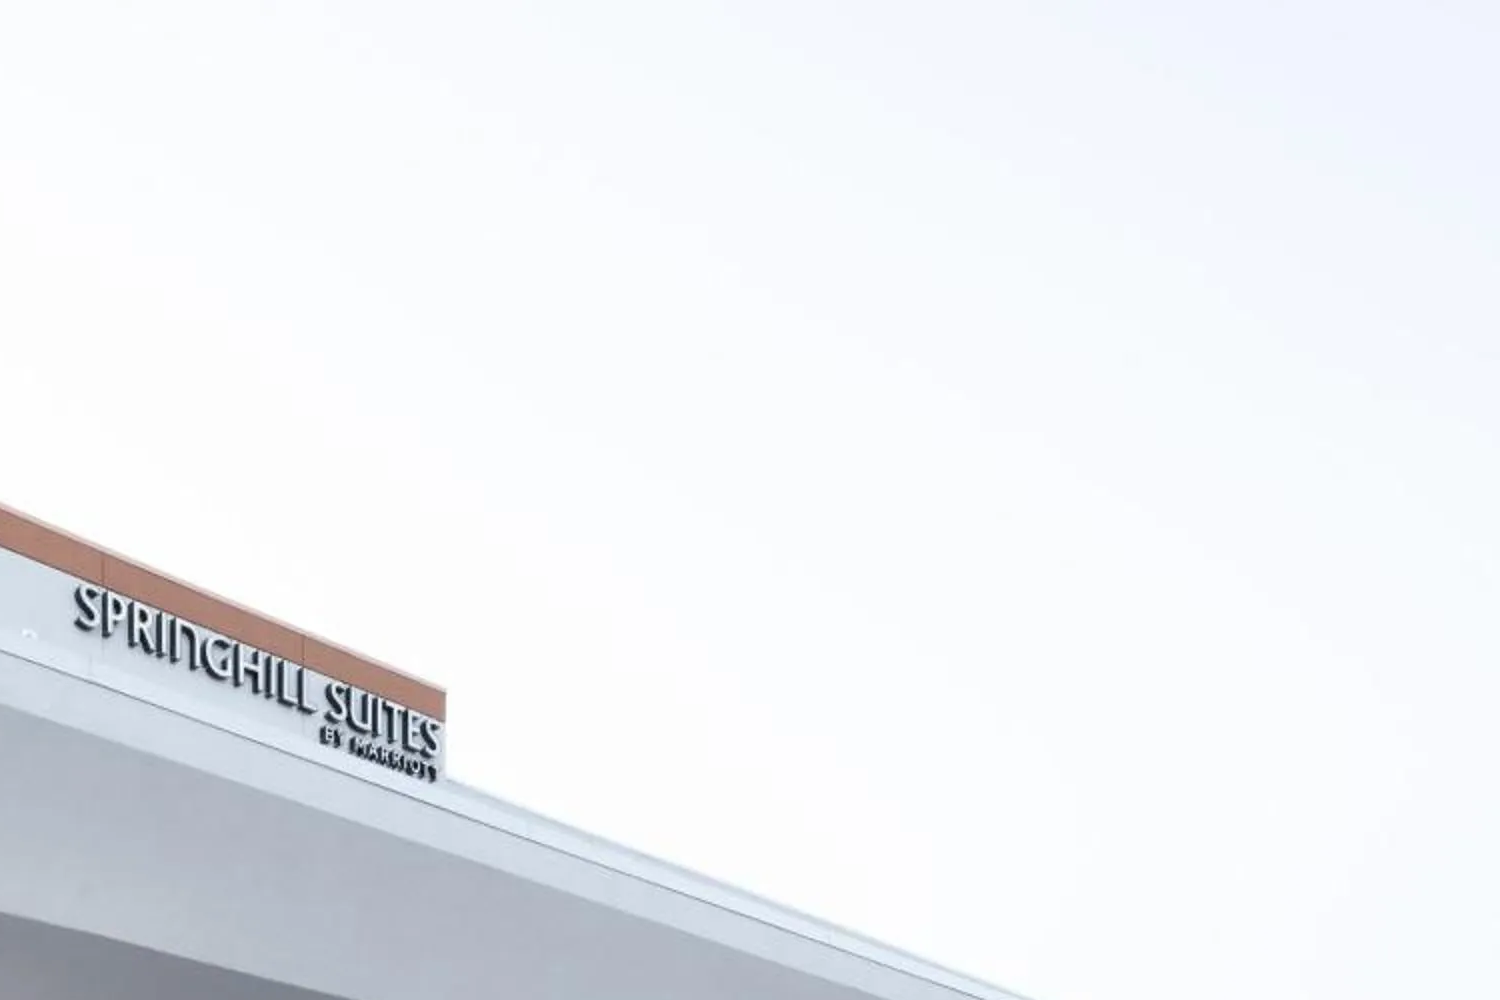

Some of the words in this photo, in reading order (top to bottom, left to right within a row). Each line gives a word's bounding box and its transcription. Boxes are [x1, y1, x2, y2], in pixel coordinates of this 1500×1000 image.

[74, 583, 316, 714] SPRINGHILL
[324, 681, 442, 759] SUITES
[320, 725, 342, 749] BY
[348, 736, 437, 783] MARRIOTT
